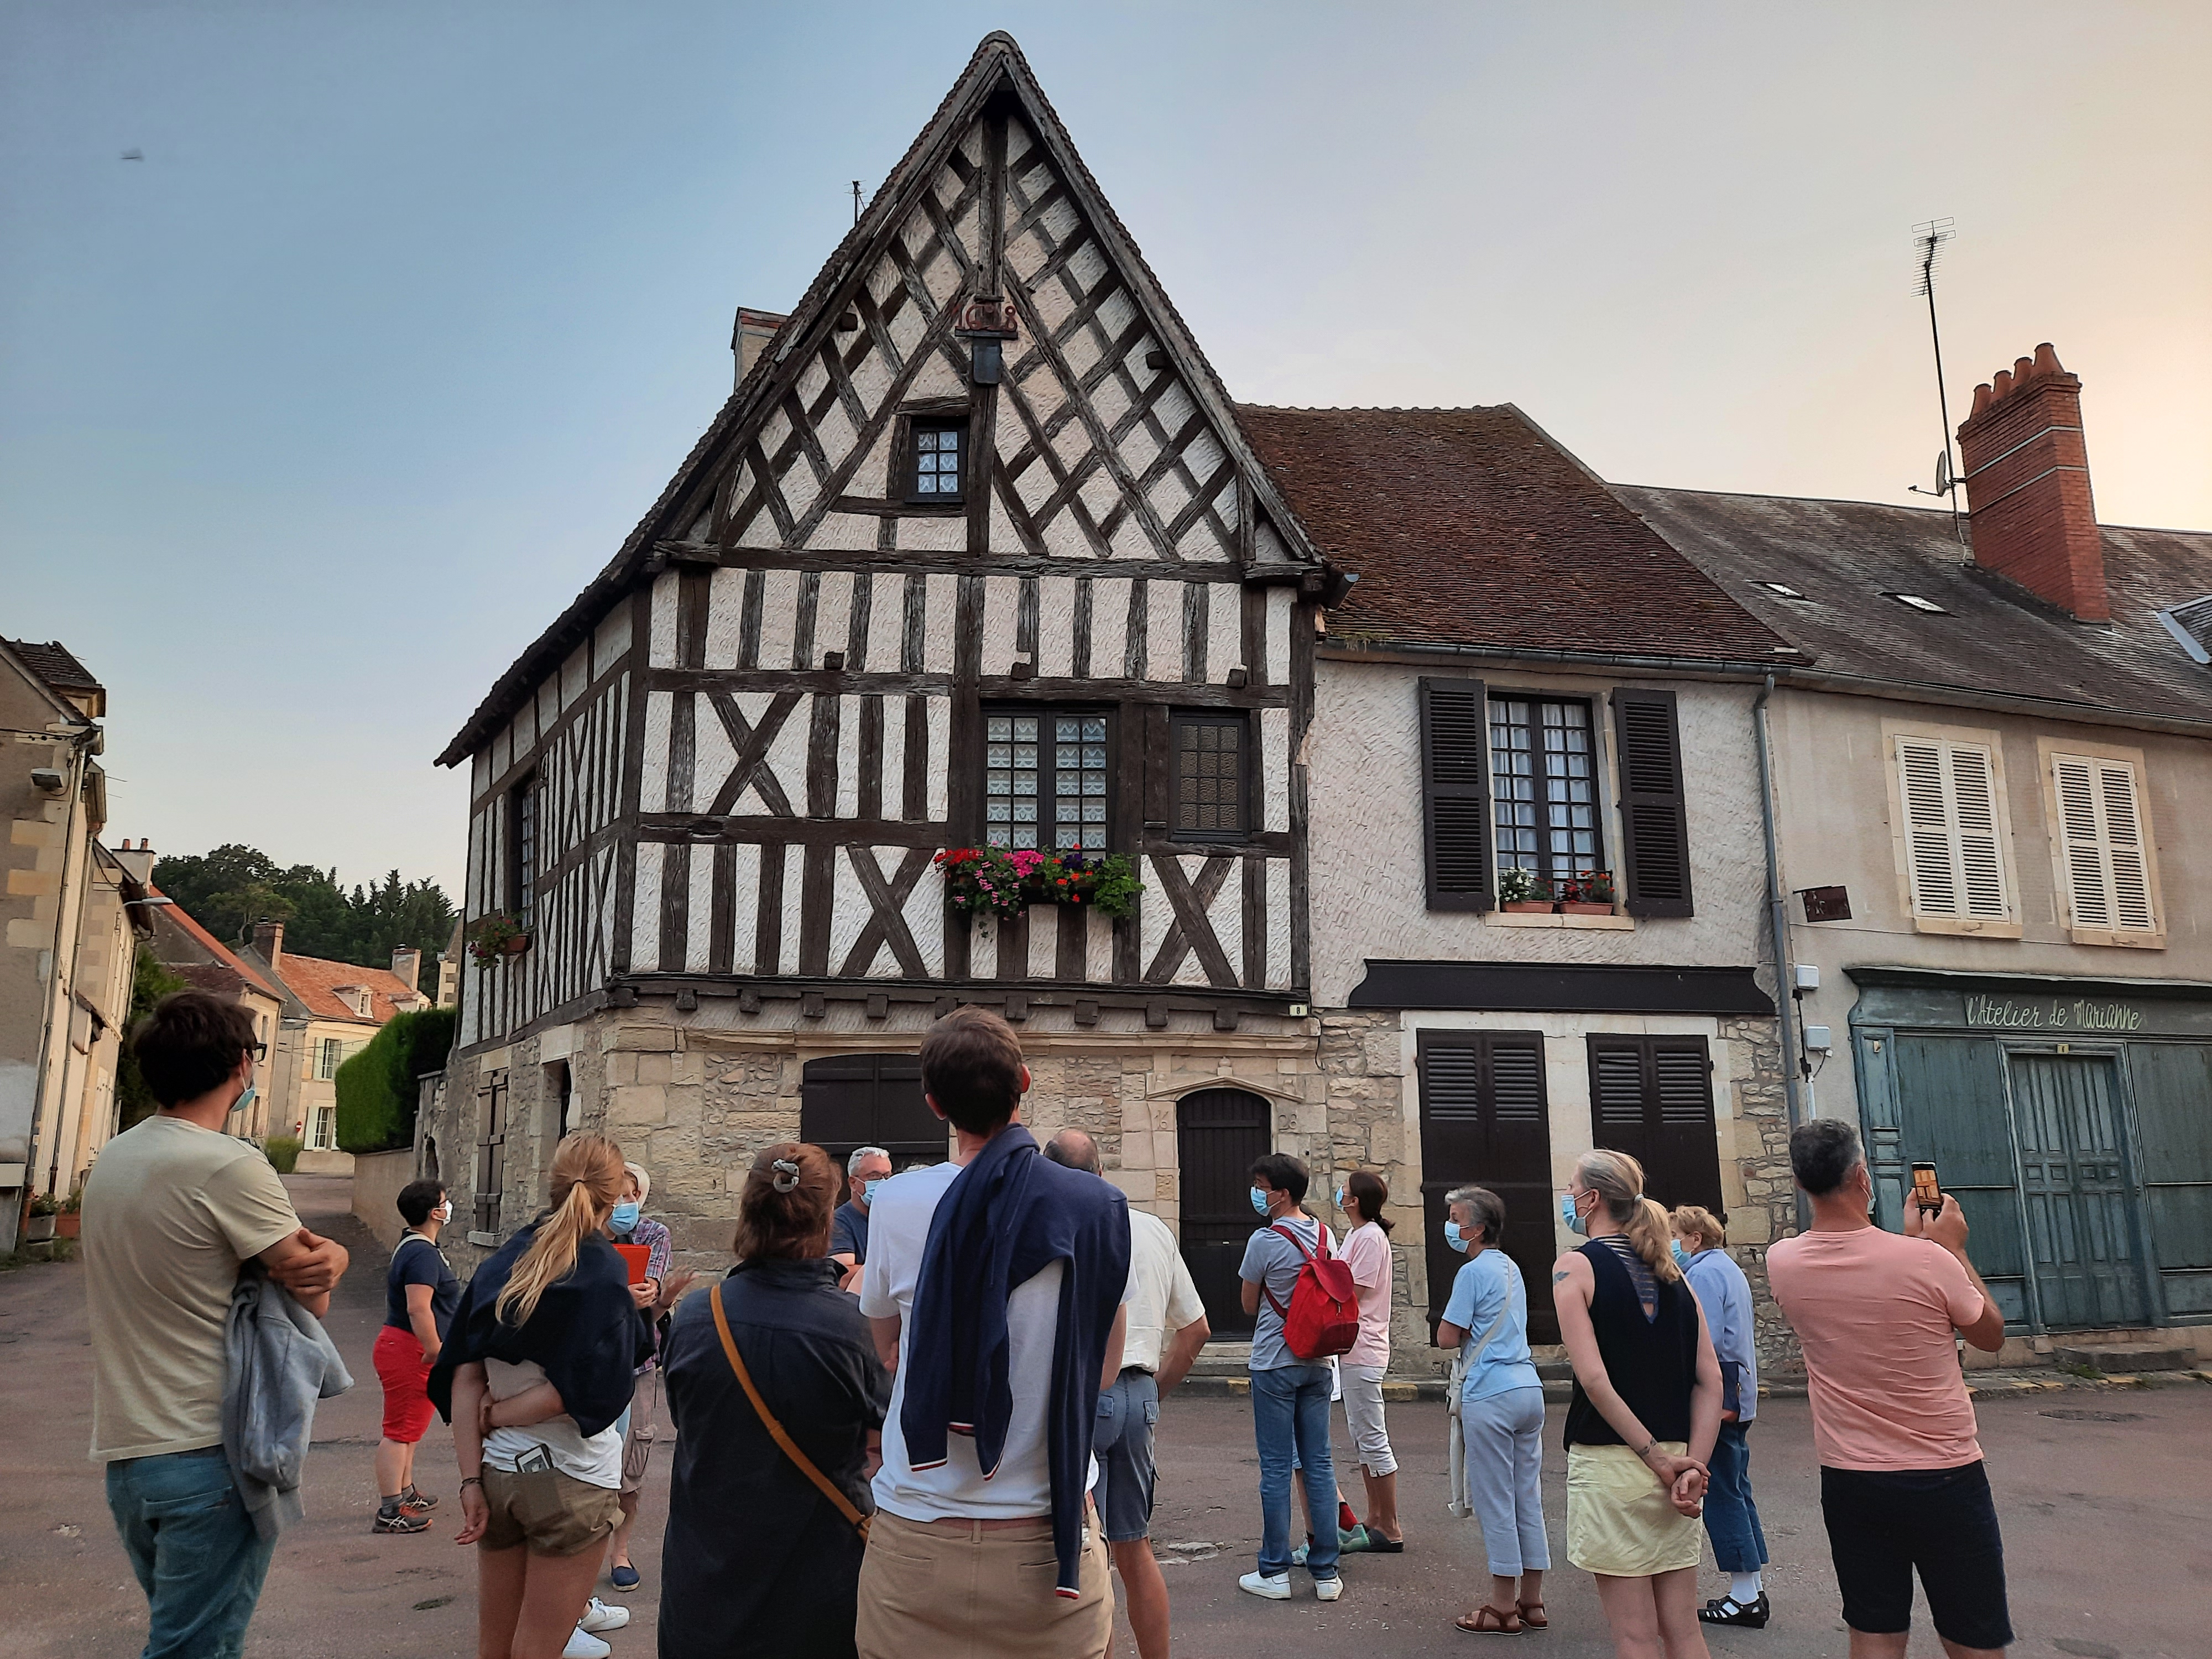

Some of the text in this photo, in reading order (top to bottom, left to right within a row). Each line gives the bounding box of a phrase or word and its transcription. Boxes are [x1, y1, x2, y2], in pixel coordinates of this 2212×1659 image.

[1968, 994, 2043, 1027] l'Atelier
[2049, 999, 2068, 1026] de
[1278, 1114, 1297, 1130] 28
